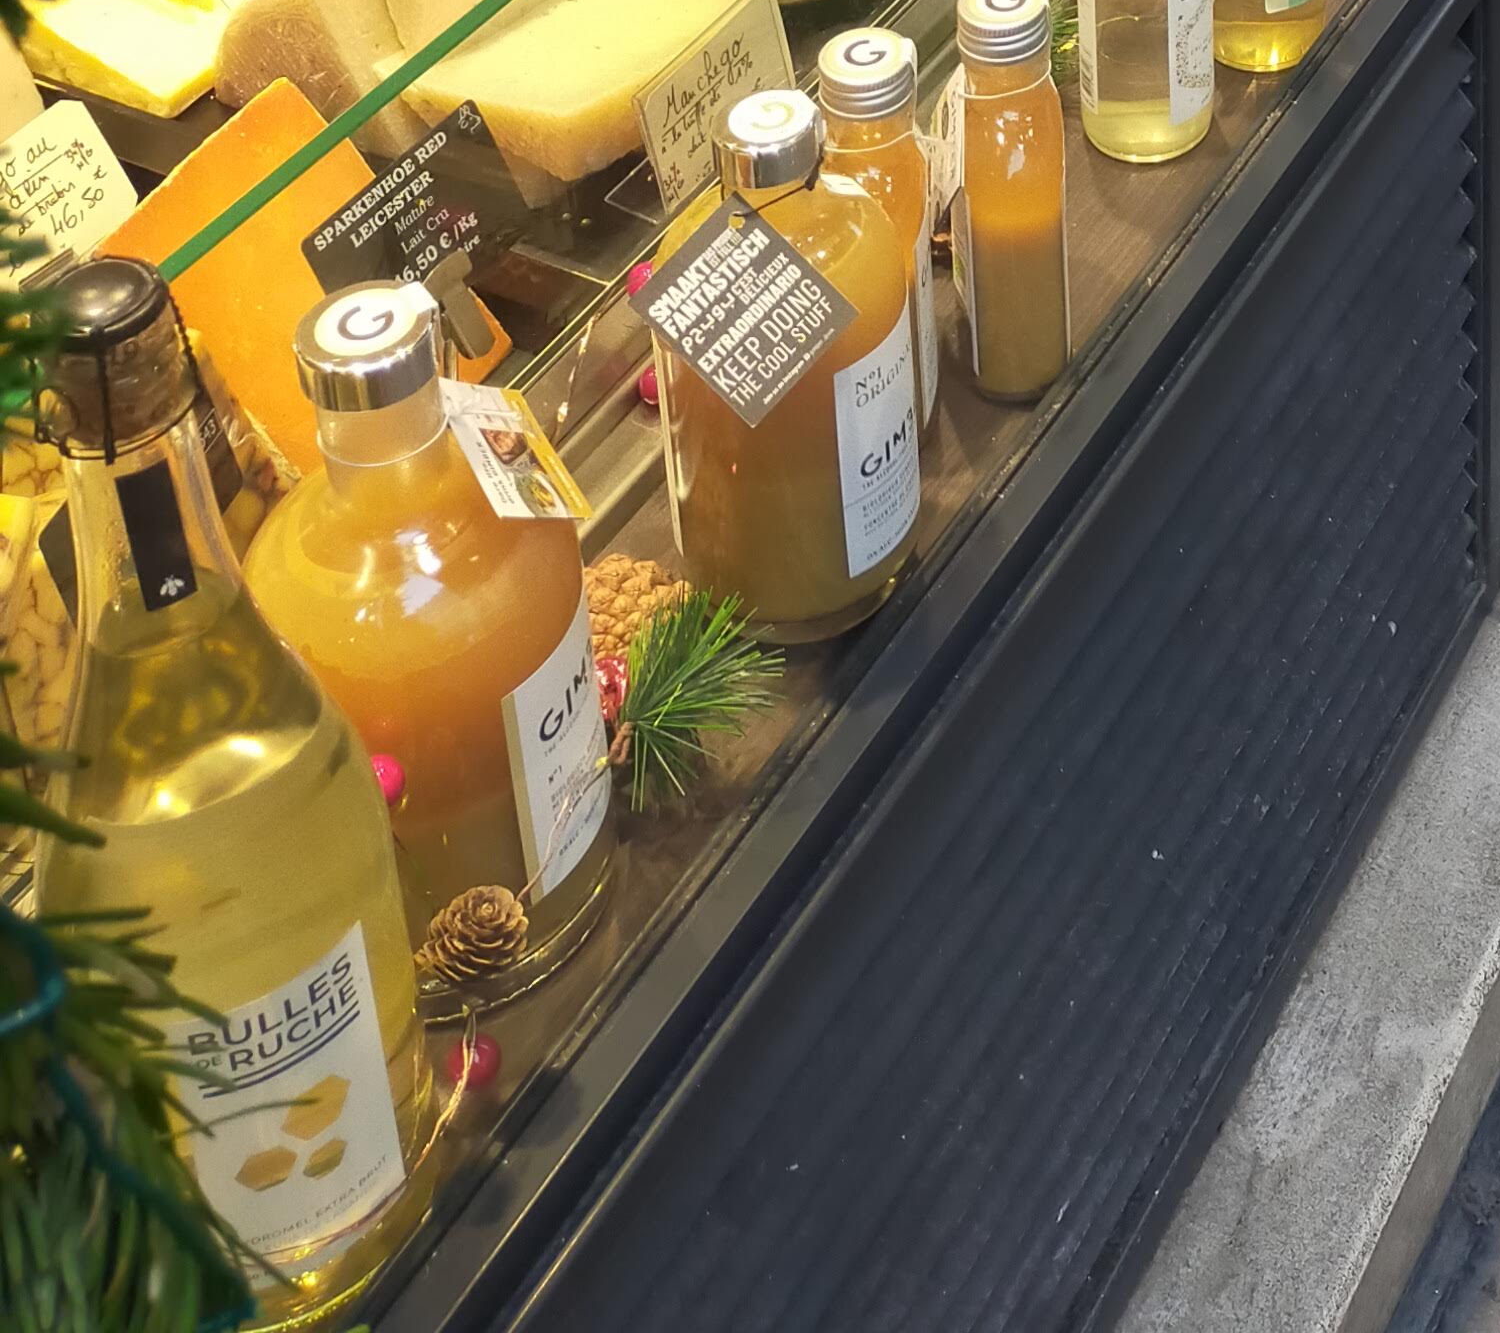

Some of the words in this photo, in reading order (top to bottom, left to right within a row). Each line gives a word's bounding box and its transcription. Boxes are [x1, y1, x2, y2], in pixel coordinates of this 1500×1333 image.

[663, 32, 745, 128] Manchego
[843, 38, 887, 67] G
[311, 157, 419, 253] SPARKENHOE
[413, 129, 449, 166] RED
[348, 169, 436, 250] LEICESTER
[393, 192, 437, 236] Mature
[400, 224, 429, 256] Lait
[425, 205, 452, 235] Cru
[336, 305, 395, 341] G
[648, 252, 711, 323] SMAAKT
[662, 227, 771, 341] FANTASTISCH
[697, 263, 803, 374] EXTRAORDINARIO
[731, 266, 760, 296] C'EST
[711, 335, 761, 395] KEEP
[759, 278, 823, 344] DOING
[729, 375, 763, 407] THE
[756, 340, 797, 380] COOL
[790, 295, 834, 343] STUFF
[186, 951, 354, 1056] BULLES
[228, 982, 359, 1072] RUCHE
[315, 1182, 358, 1220] EXTRA
[358, 1155, 390, 1188] BRUT
